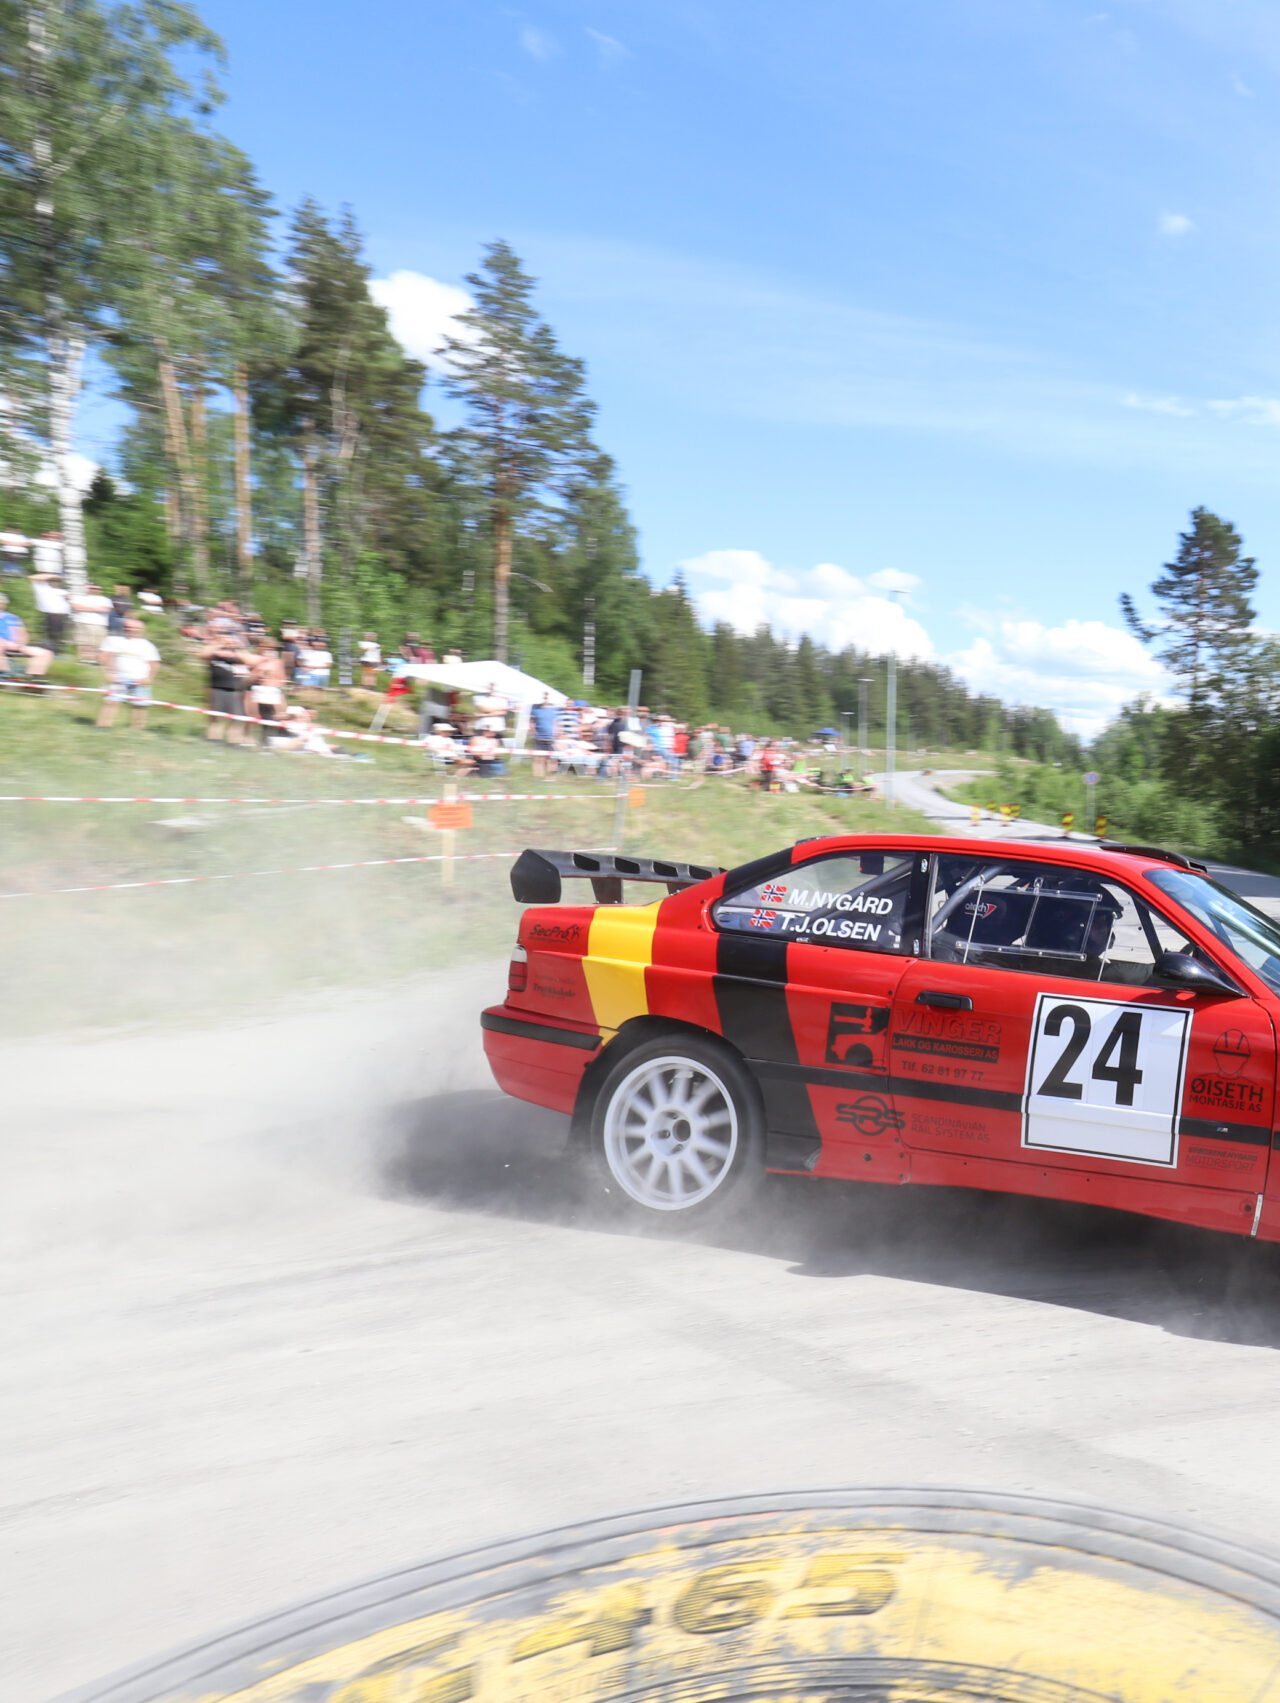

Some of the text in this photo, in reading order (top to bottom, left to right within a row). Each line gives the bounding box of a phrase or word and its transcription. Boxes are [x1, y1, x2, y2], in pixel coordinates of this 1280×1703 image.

[788, 888, 893, 915] M.NYGÅRD
[781, 913, 881, 941] T.J.OLSEN
[898, 1009, 1002, 1043] VINGER
[892, 1037, 998, 1060] LAKK OG KAROSSERI AS
[1036, 1004, 1143, 1106] 24
[921, 1063, 935, 1074] 62
[937, 1065, 950, 1077] 81
[954, 1067, 967, 1079] 97
[971, 1070, 984, 1081] 77
[1191, 1077, 1264, 1102] ØISETH
[1189, 1094, 1262, 1112] MONTASJE AS
[911, 1113, 986, 1132] SCANDINAVIAN
[911, 1124, 932, 1135] RAIL
[935, 1127, 975, 1141] SYSTEM
